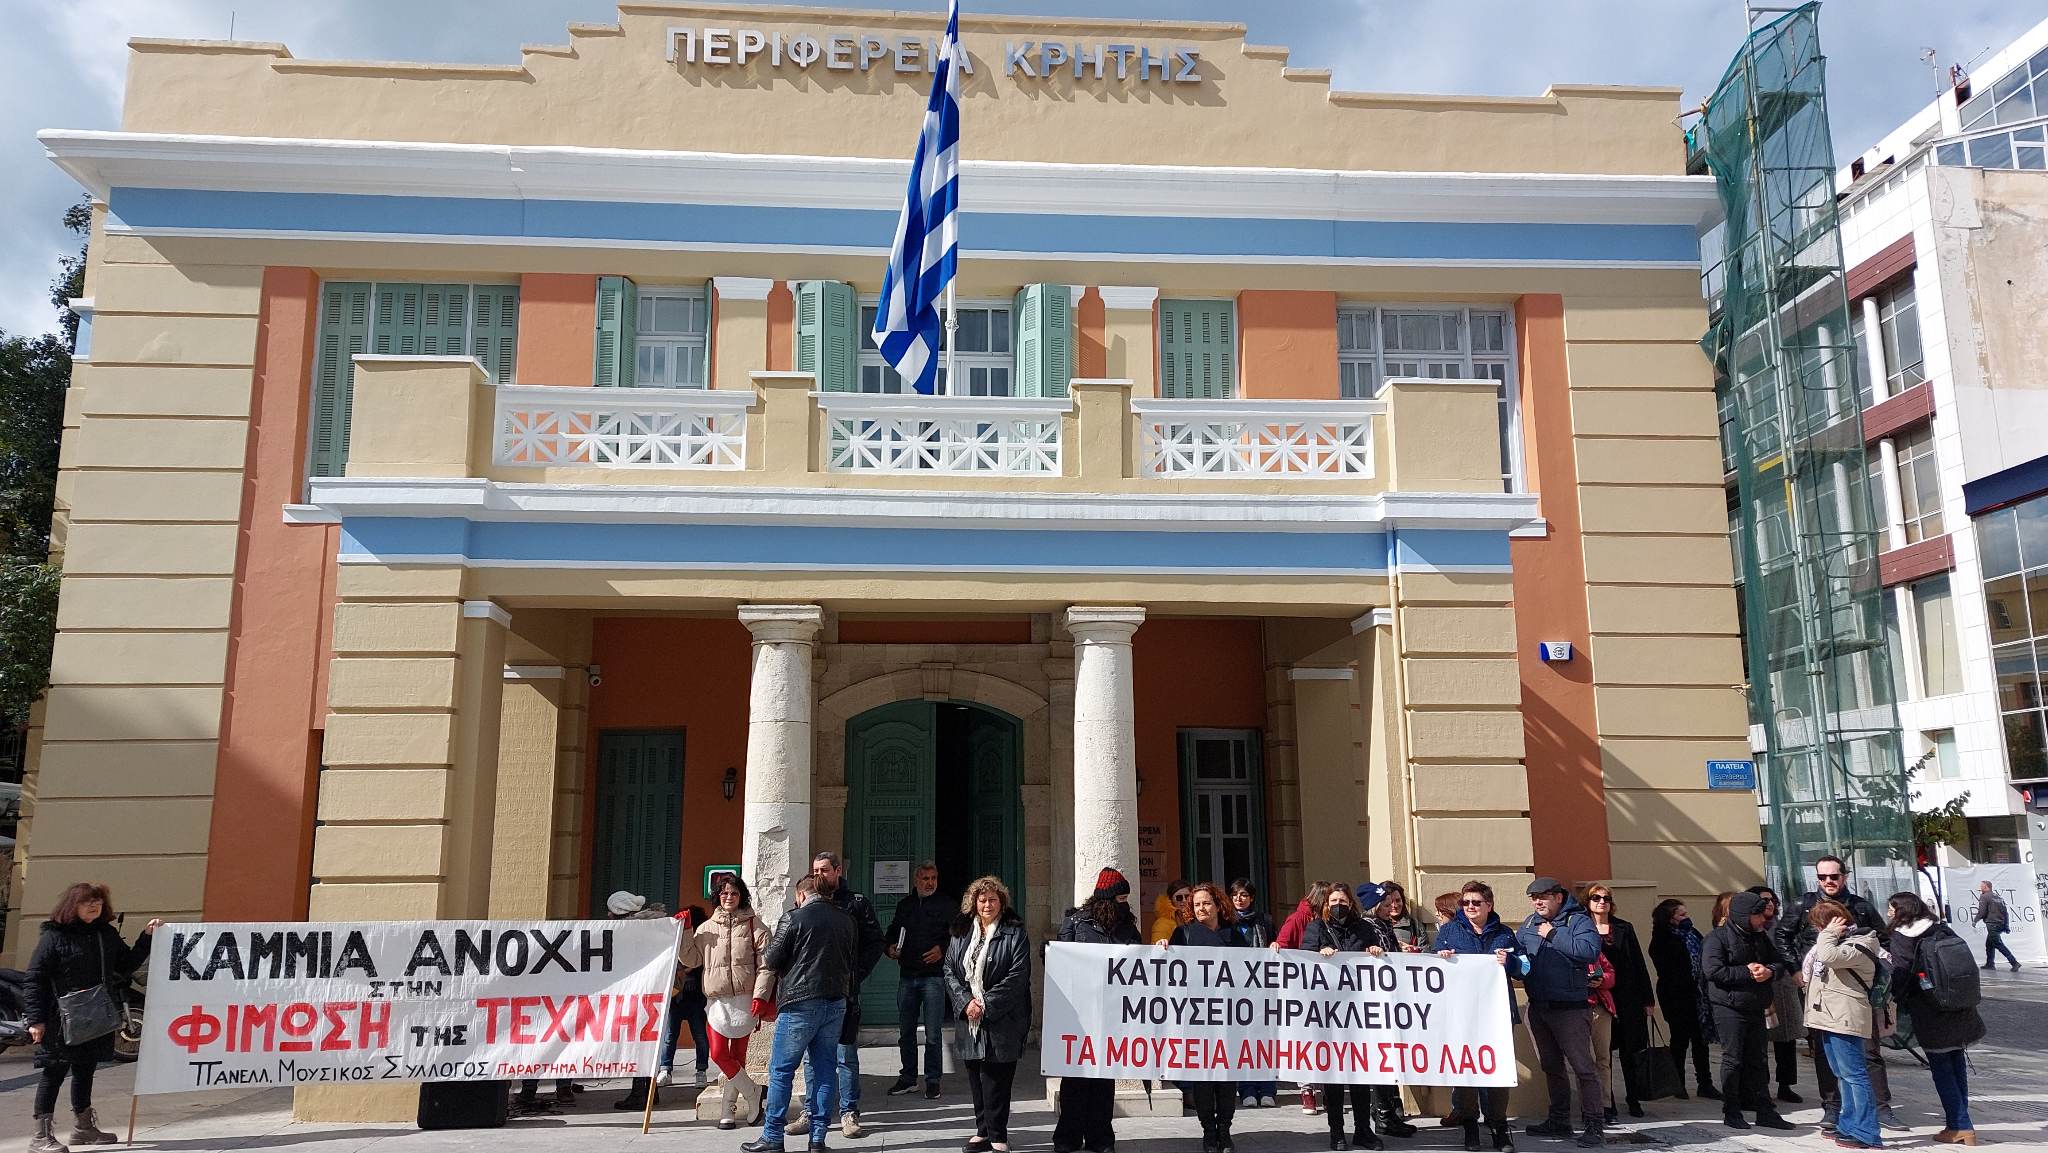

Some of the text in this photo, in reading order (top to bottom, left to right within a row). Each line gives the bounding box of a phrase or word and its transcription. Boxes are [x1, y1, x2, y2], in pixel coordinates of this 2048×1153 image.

[666, 26, 1202, 82] ΠΕΡΙΦΕΡΕΙΑ ΚΡΗΤΗΣ
[168, 929, 613, 981] ΚΑΜΜΙΑ ΑΝΟΧΗ
[368, 980, 442, 998] ΣΤΗΝ
[1107, 957, 1445, 994] ΚΑΤΩ ΤΑ ΧΕΡΙΑ ΑΠΟ ΤΟ
[168, 993, 664, 1053] ΦΙΜΩΣΗ ΤΗΣ ΤΕΧΝΗΣ
[1122, 995, 1432, 1030] ΜΟΥΣΕΙΟ ΗΡΑΚΛΕΙΟΥ
[189, 1055, 638, 1086] ΠΑΝΕΛΛ. ΜΟΥΣΙΚΟΣ ΣΥΛΛΟΓΟΣ ΠΑΡΑΡΤΗΜΑ ΚΡΗΤΗΣ
[1061, 1034, 1496, 1076] ΤΑ ΜΟΥΣΕΙΑ ΑΝΗΚΟΥΝ ΣΤΟ ΛΑΟ
